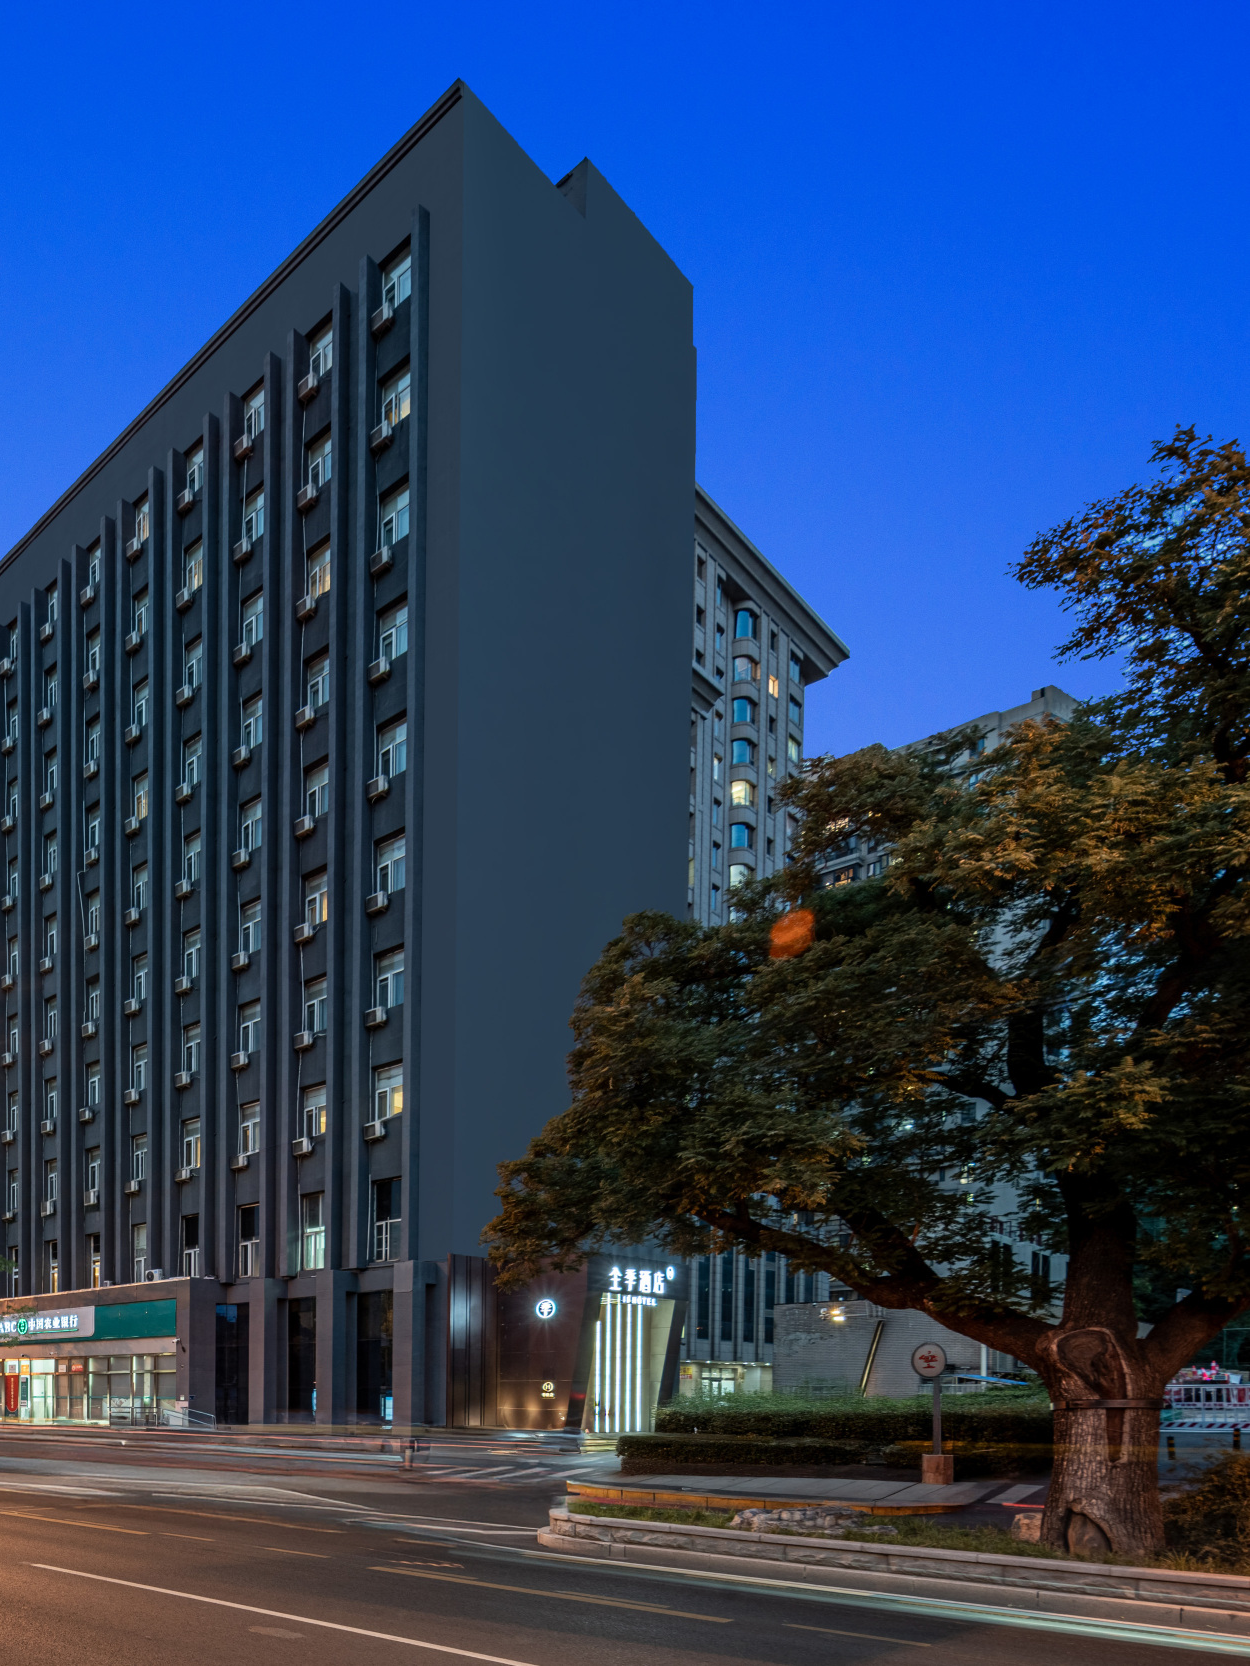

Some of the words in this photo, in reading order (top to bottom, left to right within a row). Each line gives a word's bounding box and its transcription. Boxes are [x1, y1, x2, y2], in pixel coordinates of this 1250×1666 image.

[608, 1266, 665, 1294] 全季酒店
[631, 1296, 657, 1306] HOTEL
[28, 1315, 78, 1330] 中国农业银行
